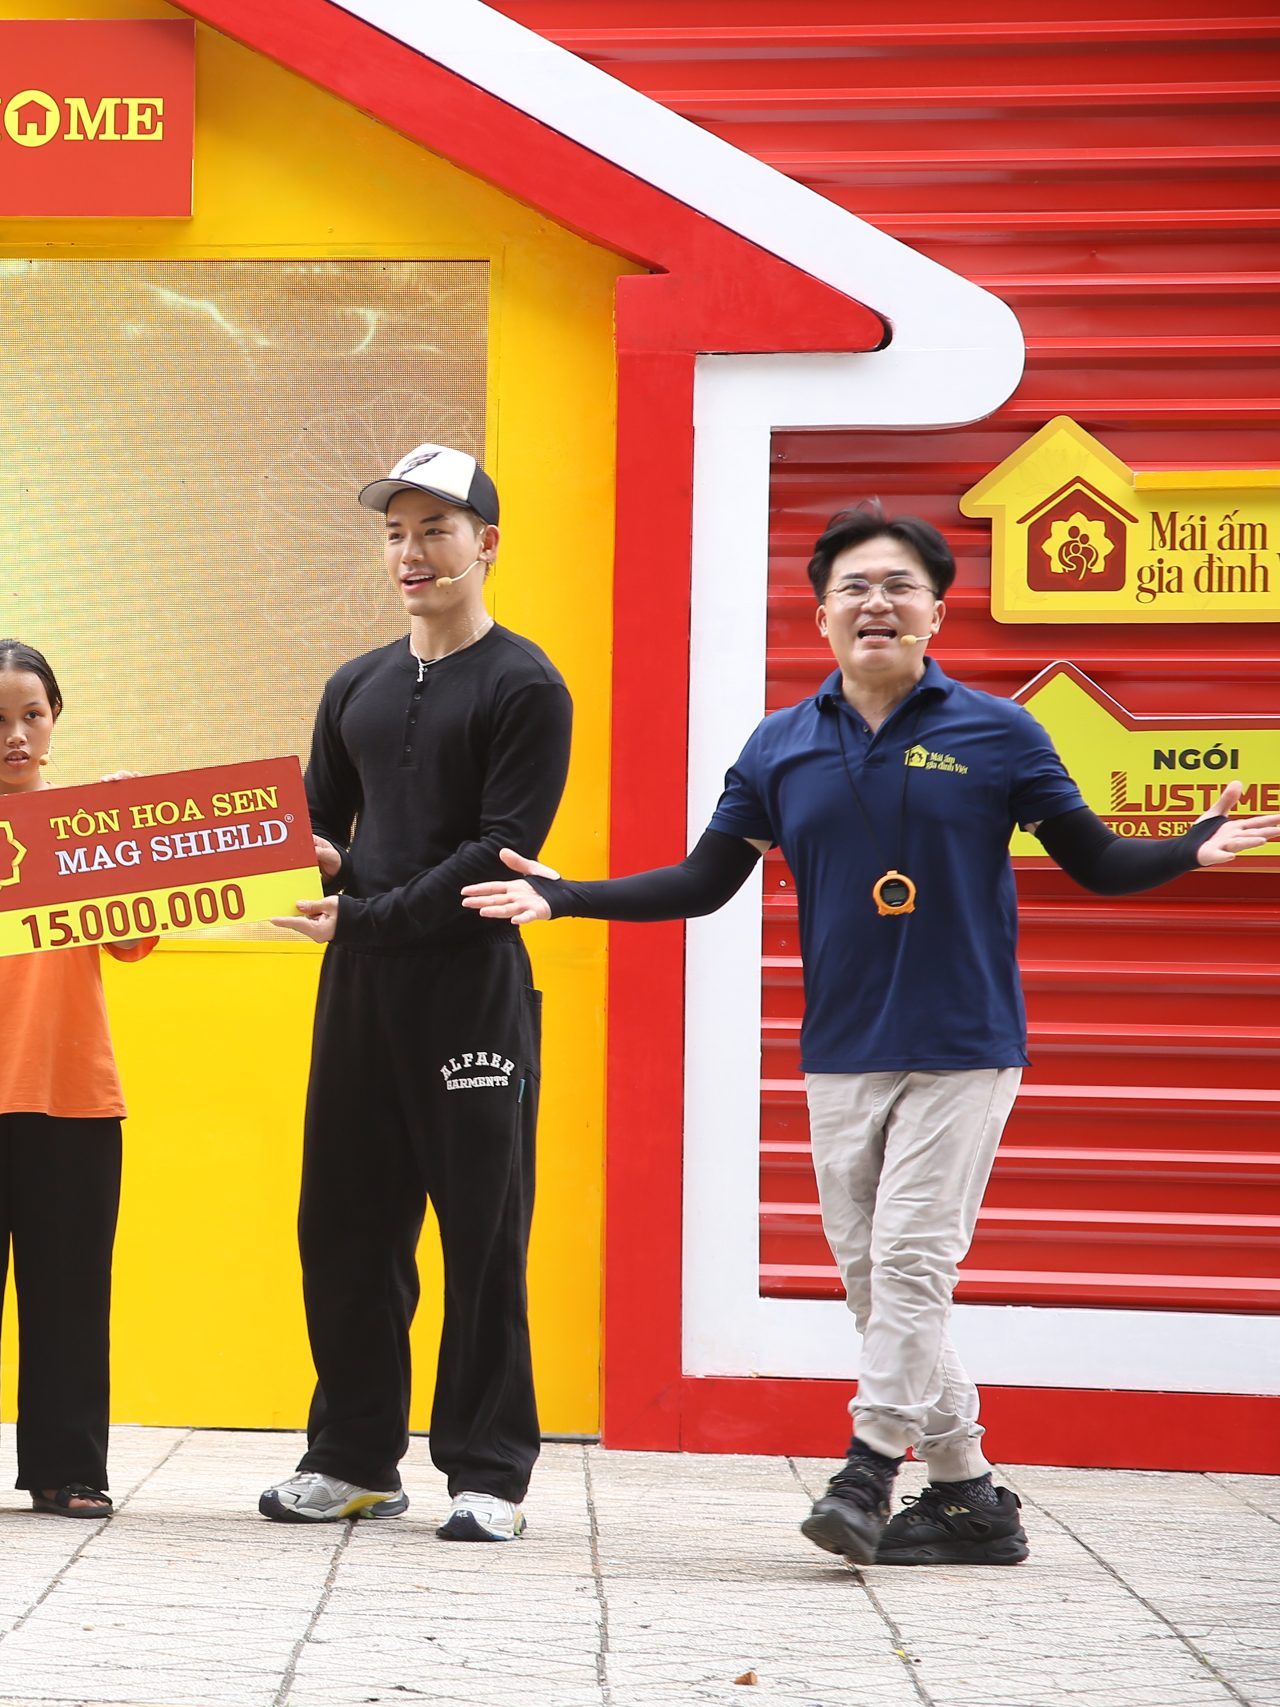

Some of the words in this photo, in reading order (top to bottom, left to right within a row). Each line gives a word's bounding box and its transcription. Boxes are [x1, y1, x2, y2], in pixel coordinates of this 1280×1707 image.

[1148, 511, 1209, 552] Mái
[1217, 509, 1269, 552] ấm
[1135, 557, 1185, 604] gia
[1194, 552, 1271, 594] đình
[1153, 742, 1240, 771] NGÓI
[49, 808, 120, 841] TÔN
[128, 798, 205, 830] HOA
[211, 786, 278, 818] SEN
[1157, 821, 1195, 838] SE
[55, 840, 142, 876] MAG
[21, 883, 246, 949] 15.000.000
